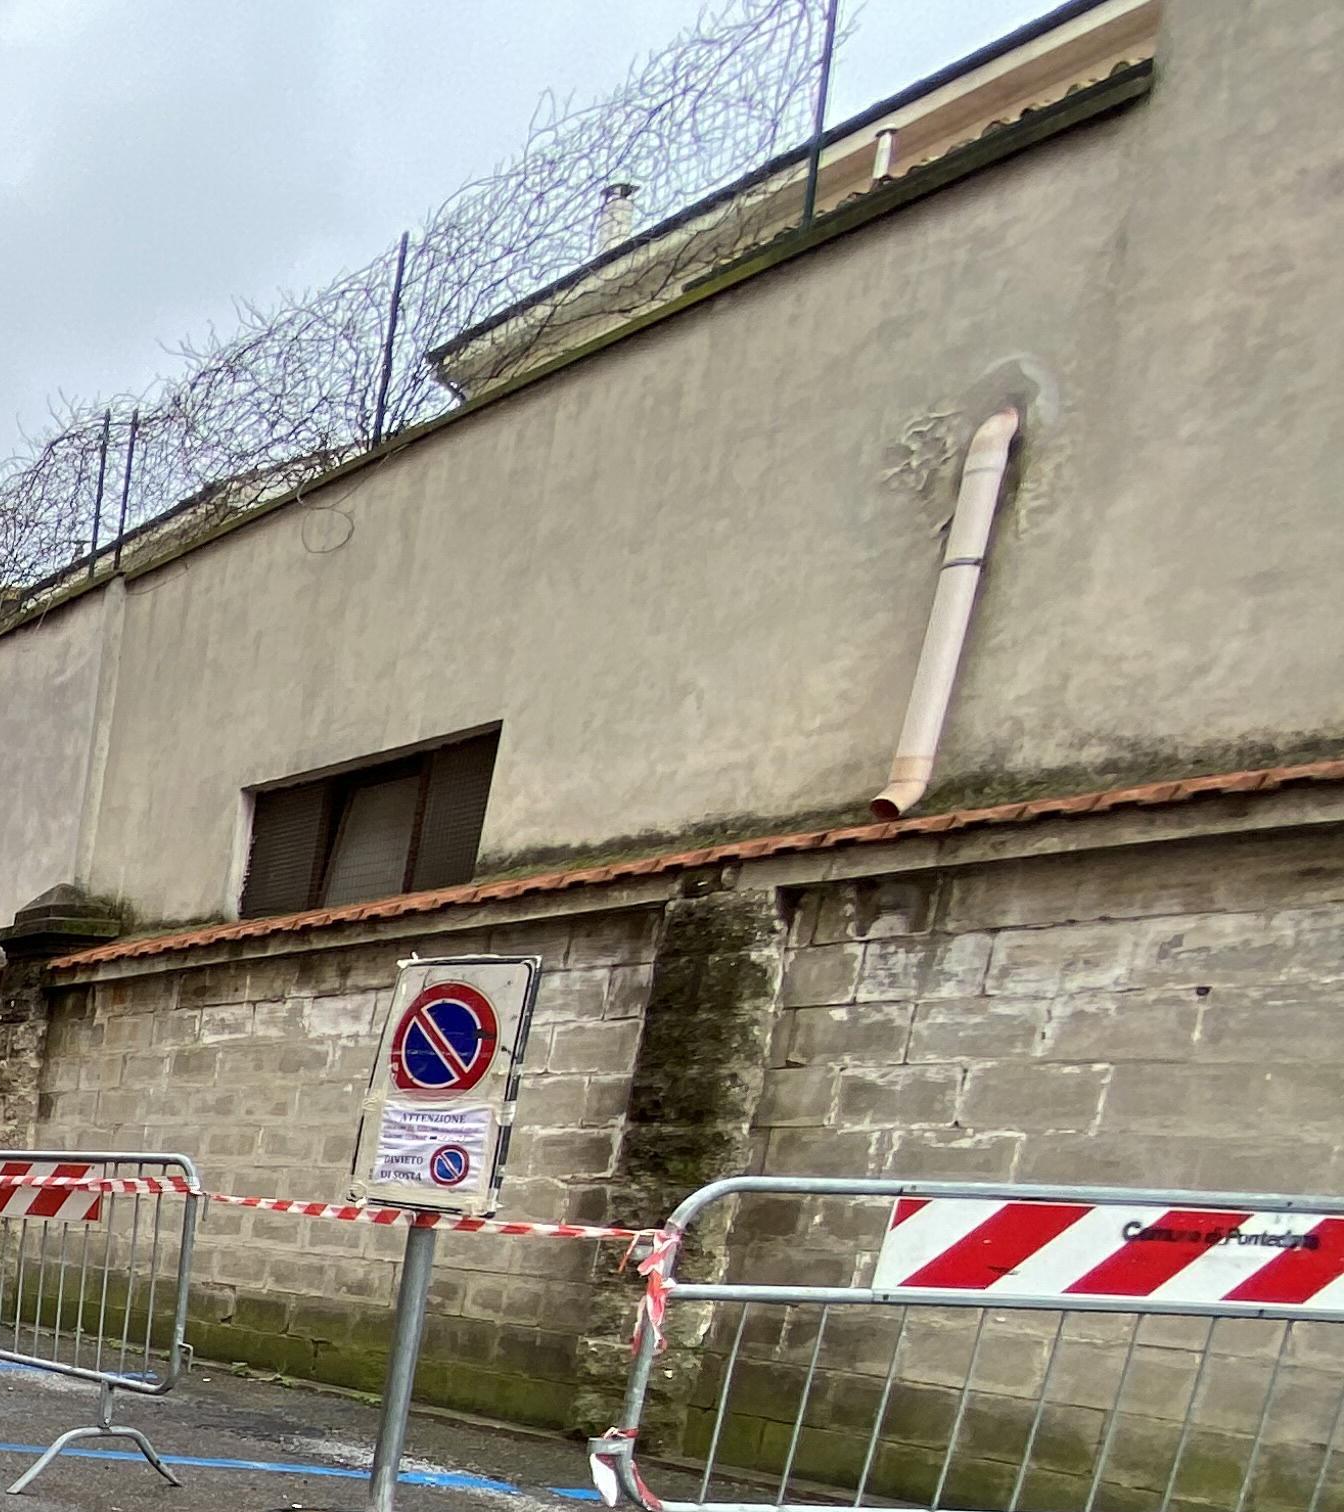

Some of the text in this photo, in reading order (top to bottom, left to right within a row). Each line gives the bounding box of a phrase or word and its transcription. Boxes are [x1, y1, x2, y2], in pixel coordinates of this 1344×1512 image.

[400, 1113, 467, 1124] ATTENZIONE
[384, 1154, 424, 1165] DIVIETO
[380, 1170, 392, 1179] DI
[393, 1170, 423, 1182] SOSTA
[1123, 1220, 1202, 1243] Comune
